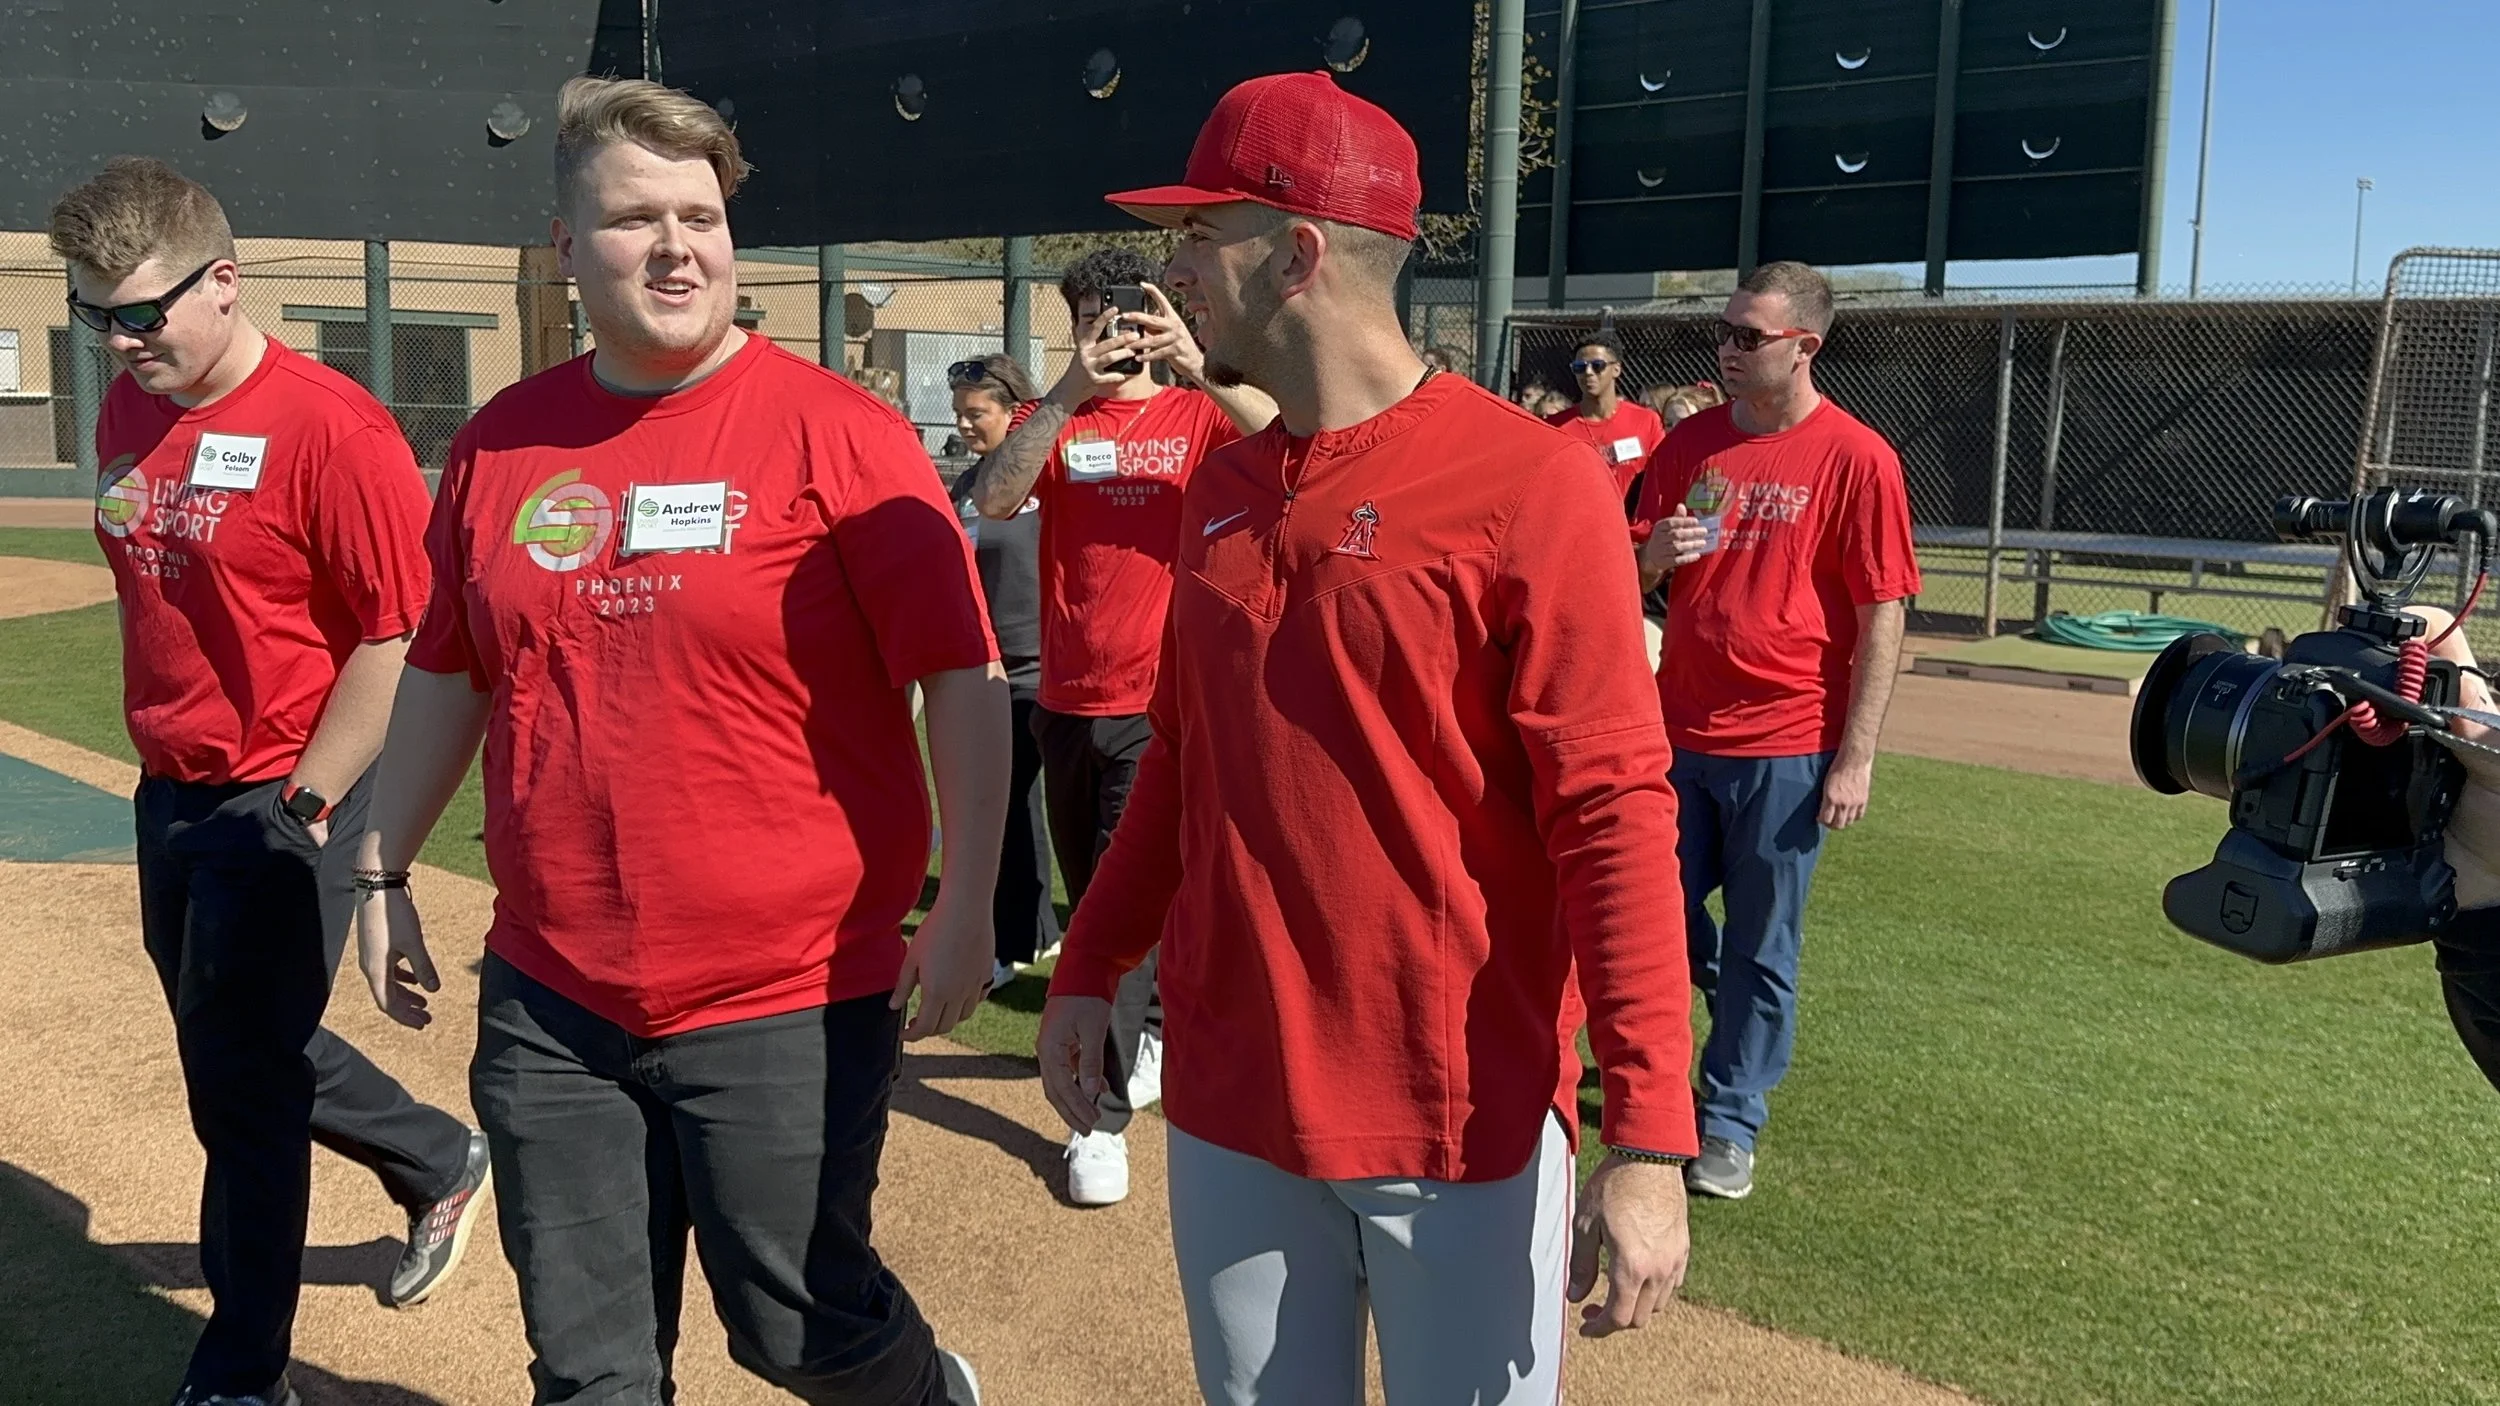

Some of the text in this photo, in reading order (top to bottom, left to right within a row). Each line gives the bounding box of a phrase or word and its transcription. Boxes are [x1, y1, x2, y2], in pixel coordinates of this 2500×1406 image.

[1120, 436, 1188, 458] LIVING
[222, 451, 257, 466] Colby
[1085, 454, 1112, 462] Rocco
[1120, 456, 1185, 476] SPORT
[1098, 485, 1160, 496] PHOENIX
[662, 502, 721, 515] Andrew
[1112, 497, 1146, 506] 2023
[1737, 500, 1803, 524] SPORT
[151, 507, 222, 543] SPORT
[670, 517, 712, 527] Hopkins
[125, 544, 189, 566] PHOENIX
[141, 564, 180, 579] 2023
[576, 575, 683, 595] PHOENIX
[600, 596, 656, 616] 2023
